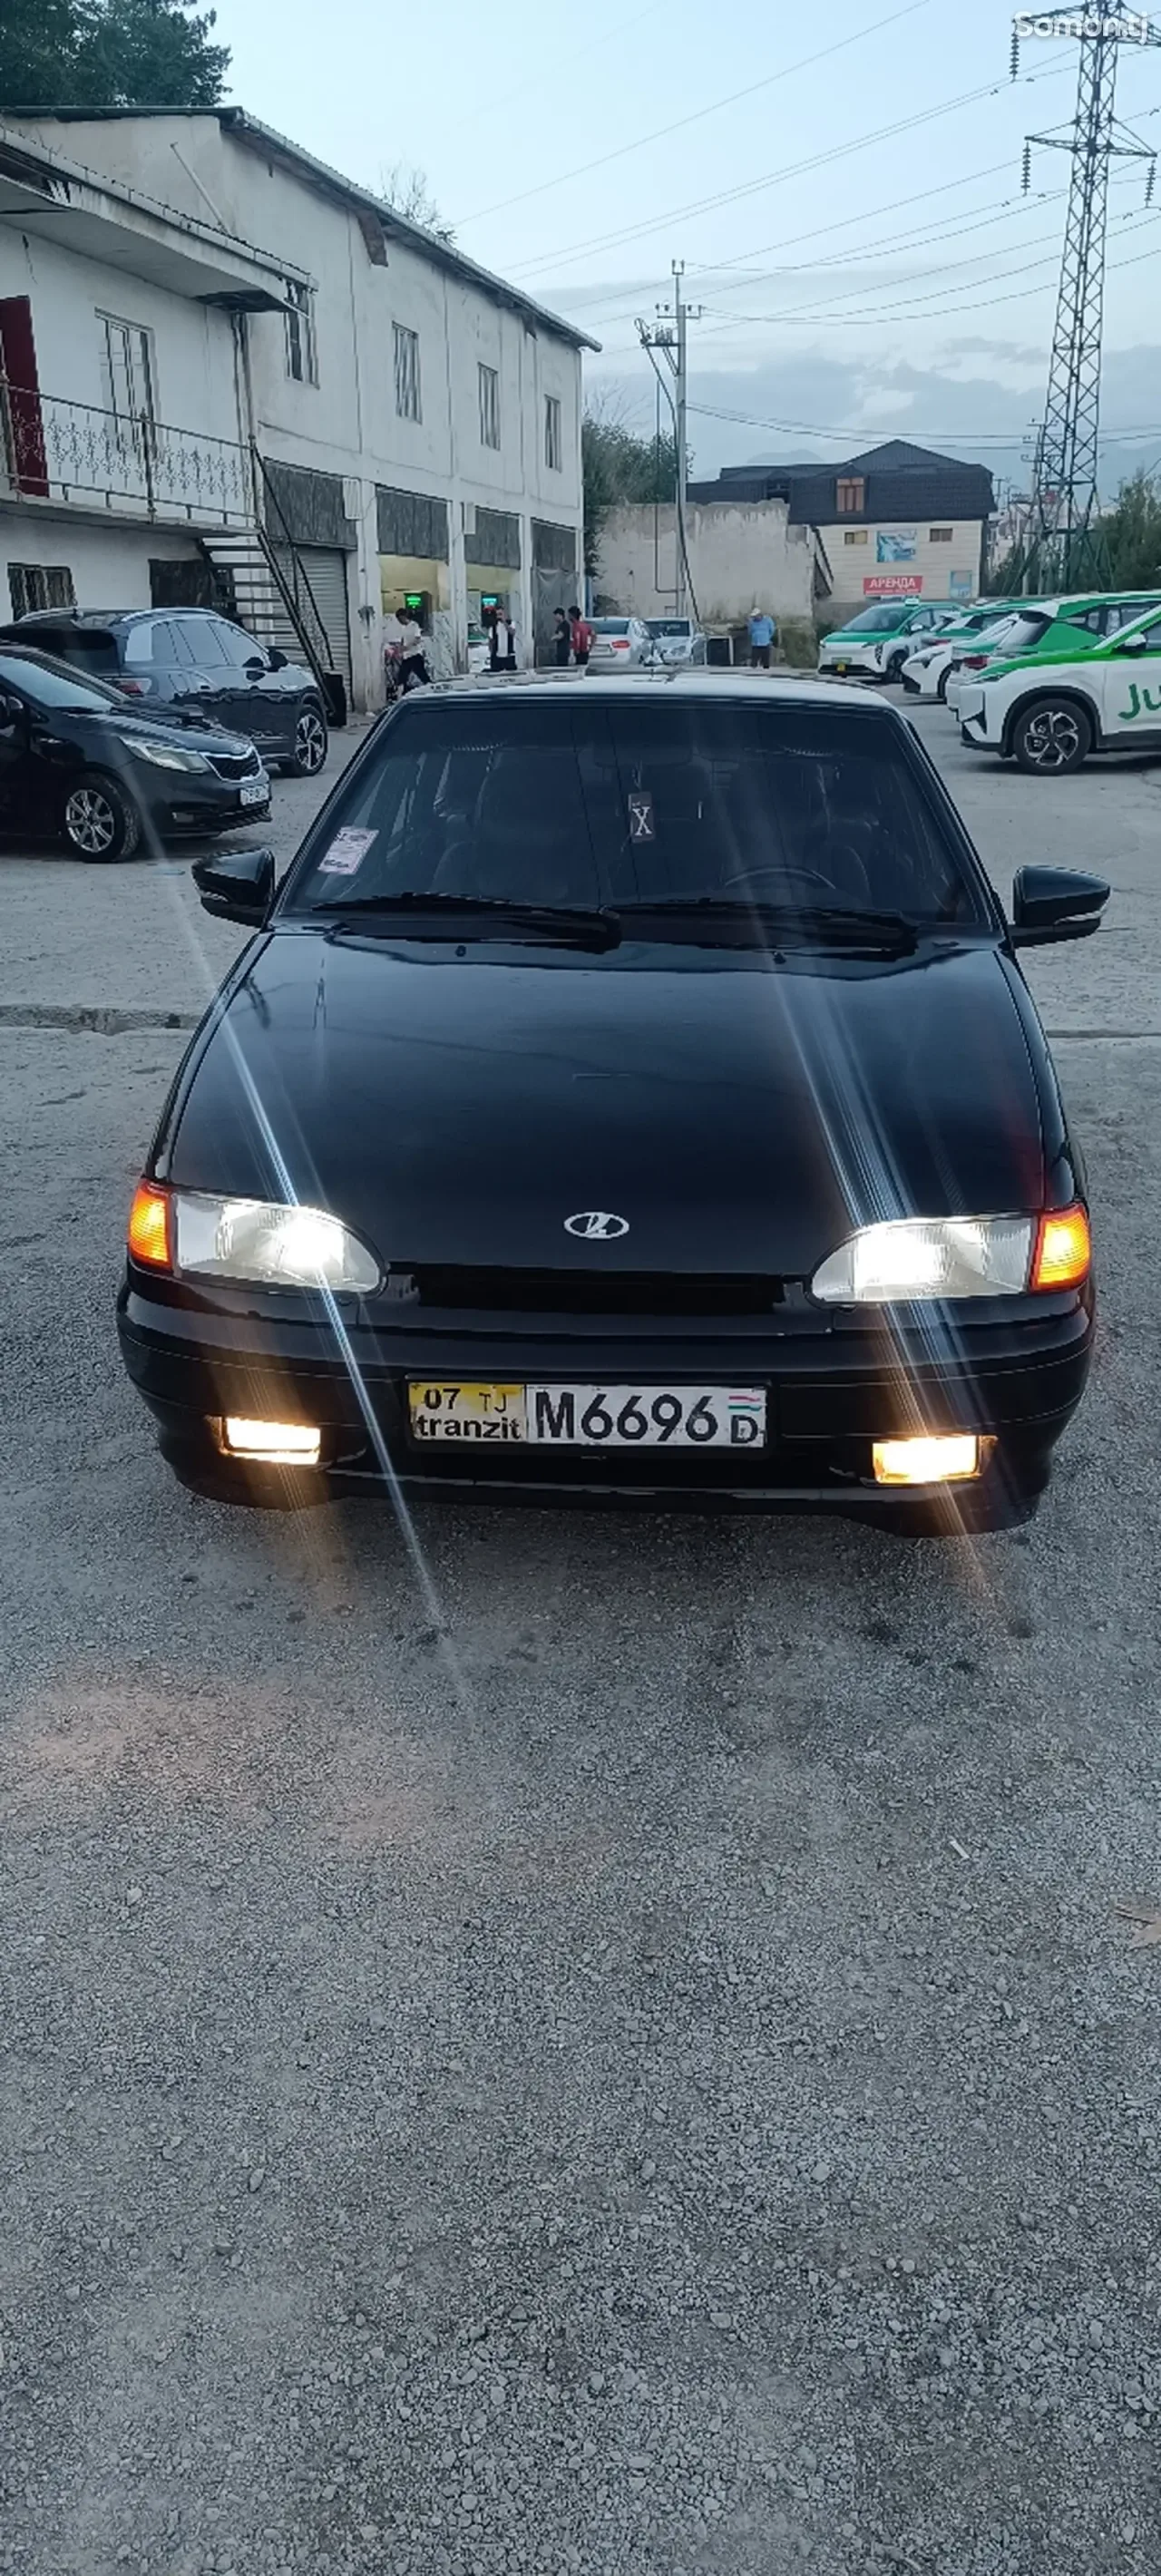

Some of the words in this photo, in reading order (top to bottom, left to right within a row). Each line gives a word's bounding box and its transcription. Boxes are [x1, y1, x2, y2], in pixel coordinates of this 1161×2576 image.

[869, 577, 916, 590] АРЕНДА
[424, 1388, 461, 1410] 07
[479, 1392, 507, 1413] TJ
[417, 1415, 522, 1440] tranzit
[536, 1391, 718, 1442] M6696
[730, 1415, 759, 1444] D
